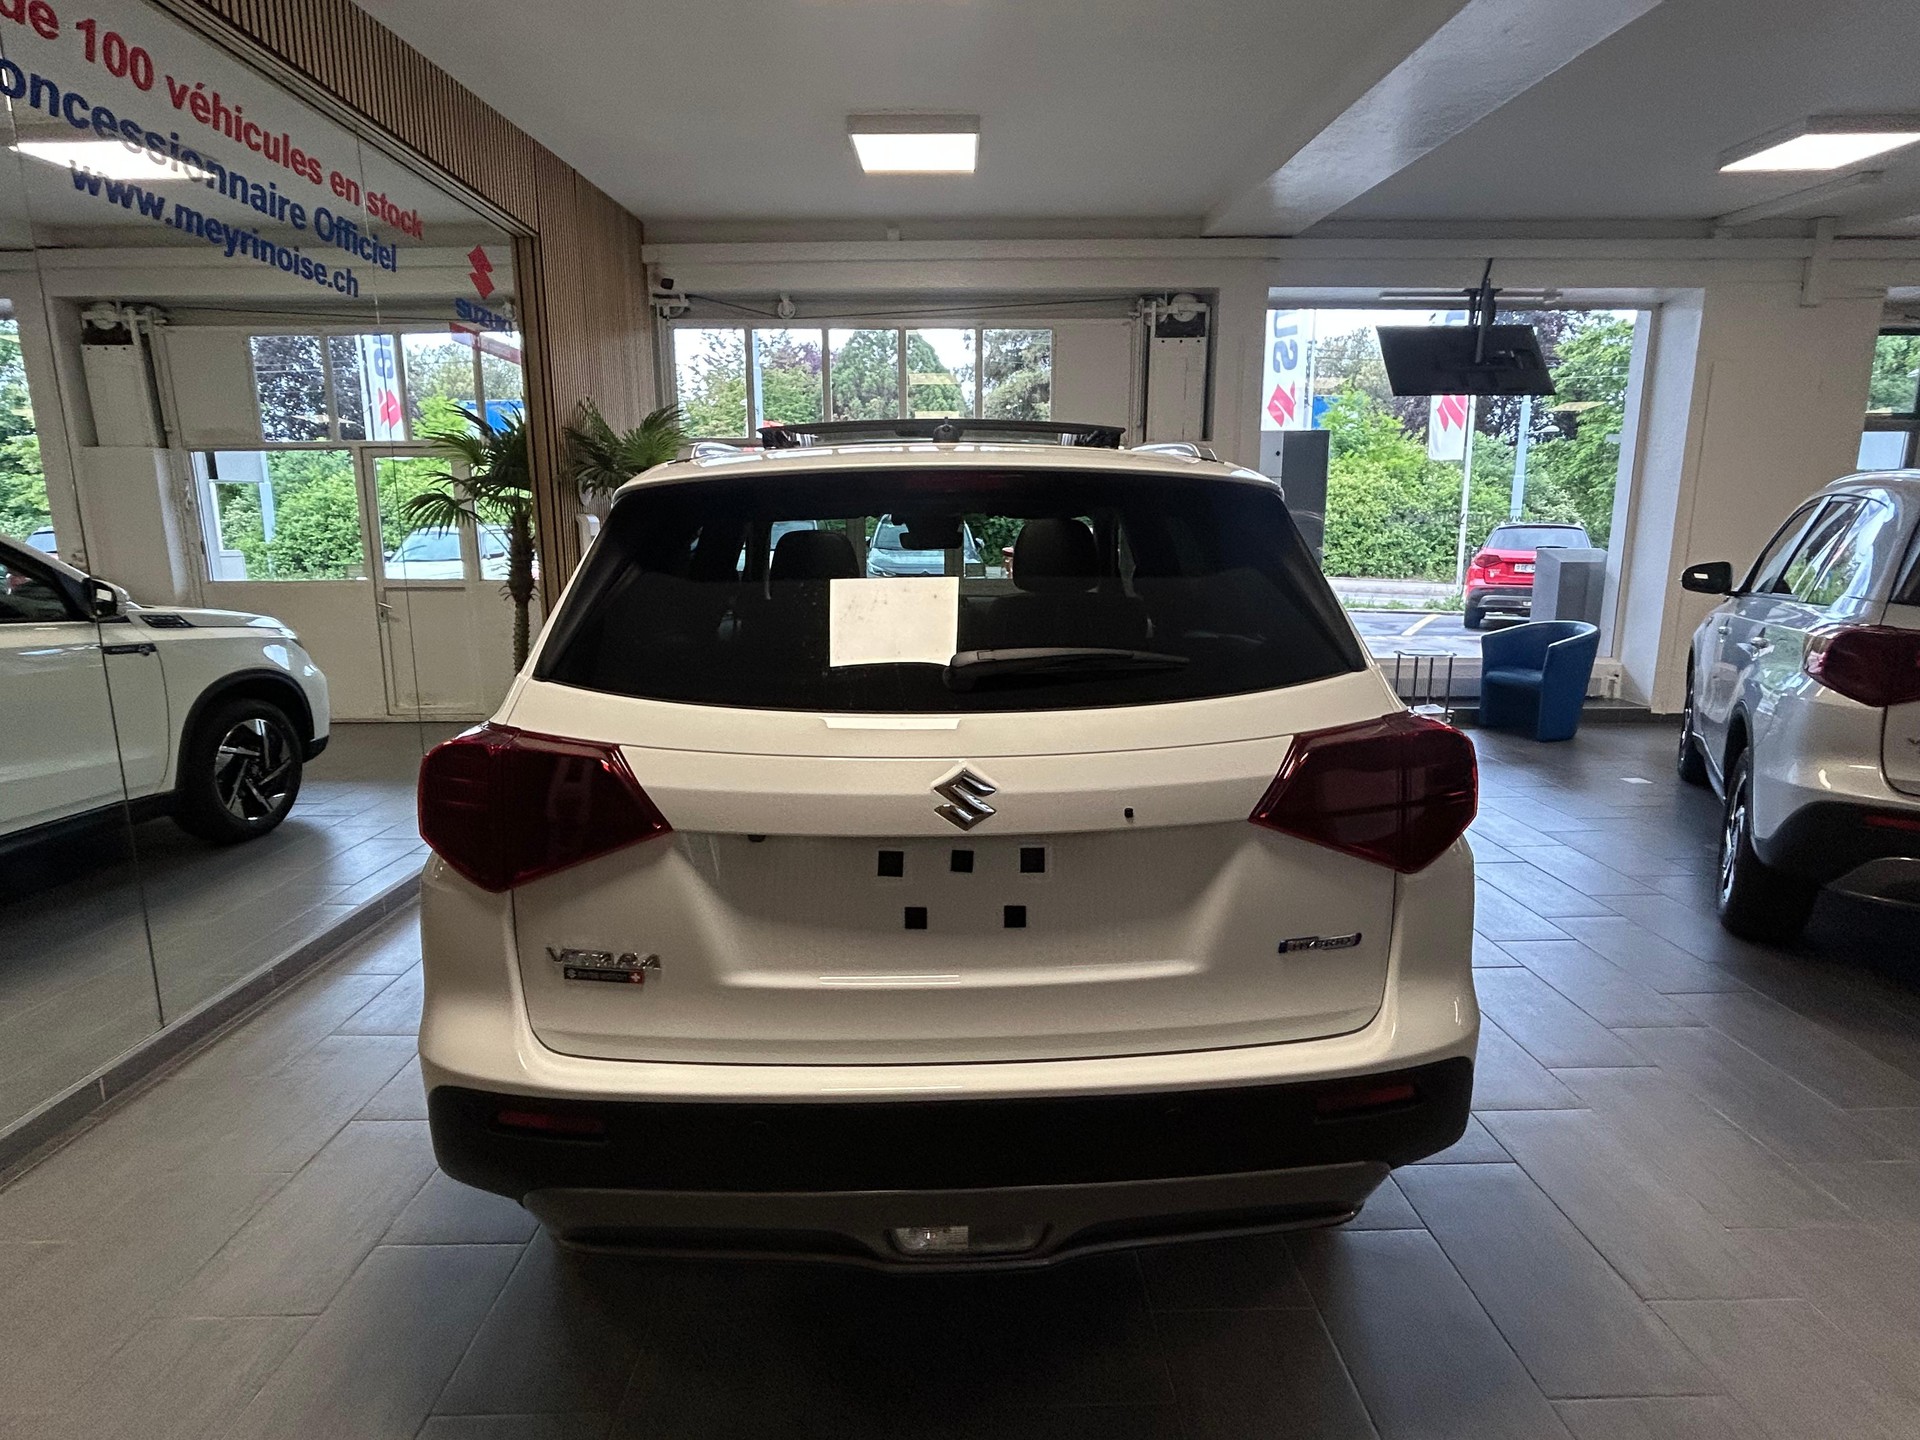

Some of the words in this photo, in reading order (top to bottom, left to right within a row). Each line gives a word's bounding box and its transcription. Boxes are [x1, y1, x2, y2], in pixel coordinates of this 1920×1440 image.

[76, 18, 154, 91] 100
[165, 75, 323, 185] véhicules
[329, 170, 360, 206] en
[366, 191, 425, 241] stock
[69, 158, 359, 298] www.meyrinoise.ch
[314, 206, 397, 272] Officiel
